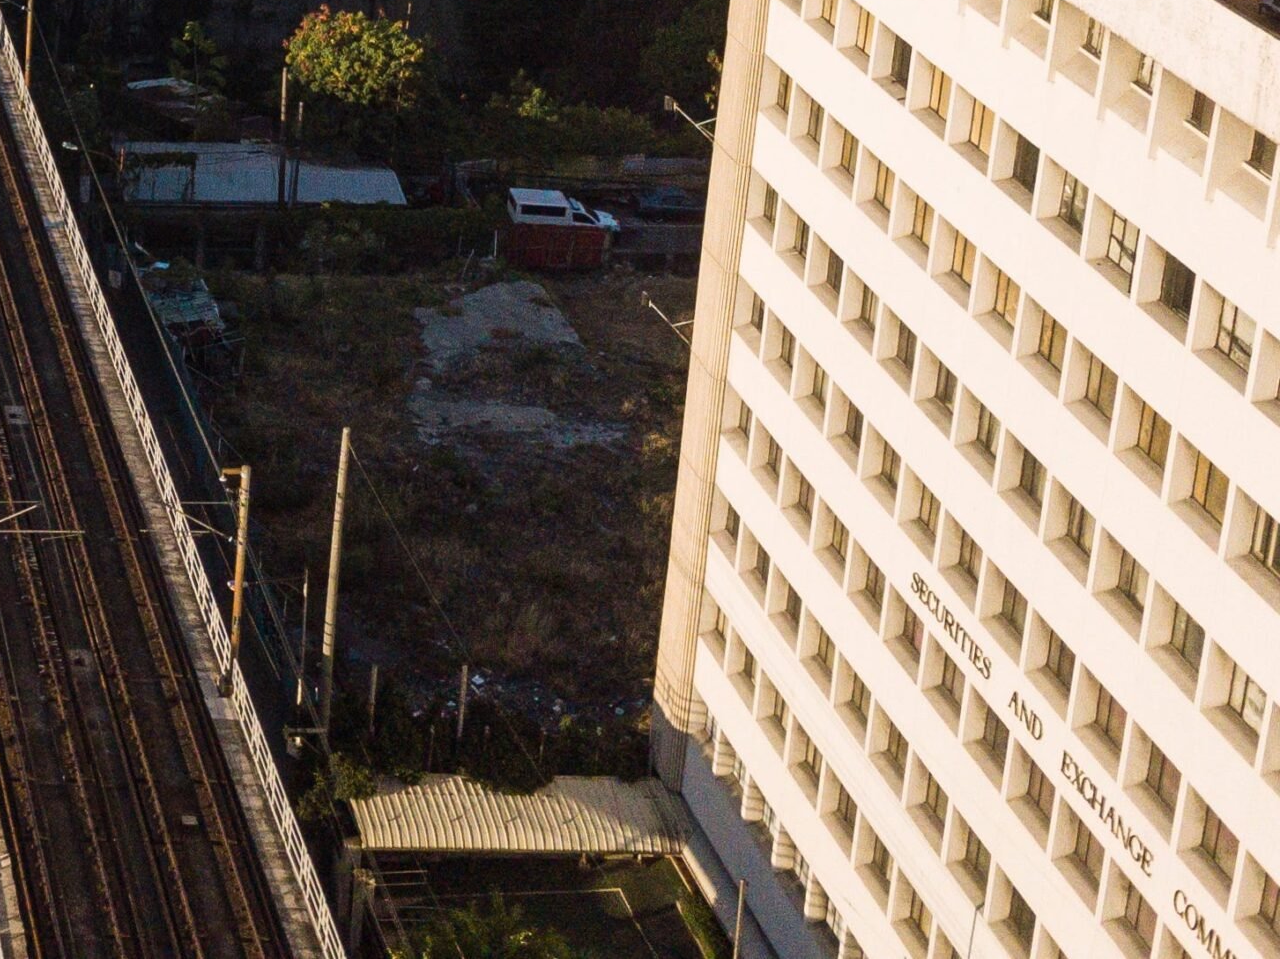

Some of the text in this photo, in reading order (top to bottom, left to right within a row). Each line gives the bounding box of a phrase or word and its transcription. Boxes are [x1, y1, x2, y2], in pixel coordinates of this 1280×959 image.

[910, 572, 992, 681] SECURITIES
[1008, 690, 1044, 741] AND
[1061, 750, 1154, 877] EXCHANGE
[1173, 889, 1238, 959] COMM
